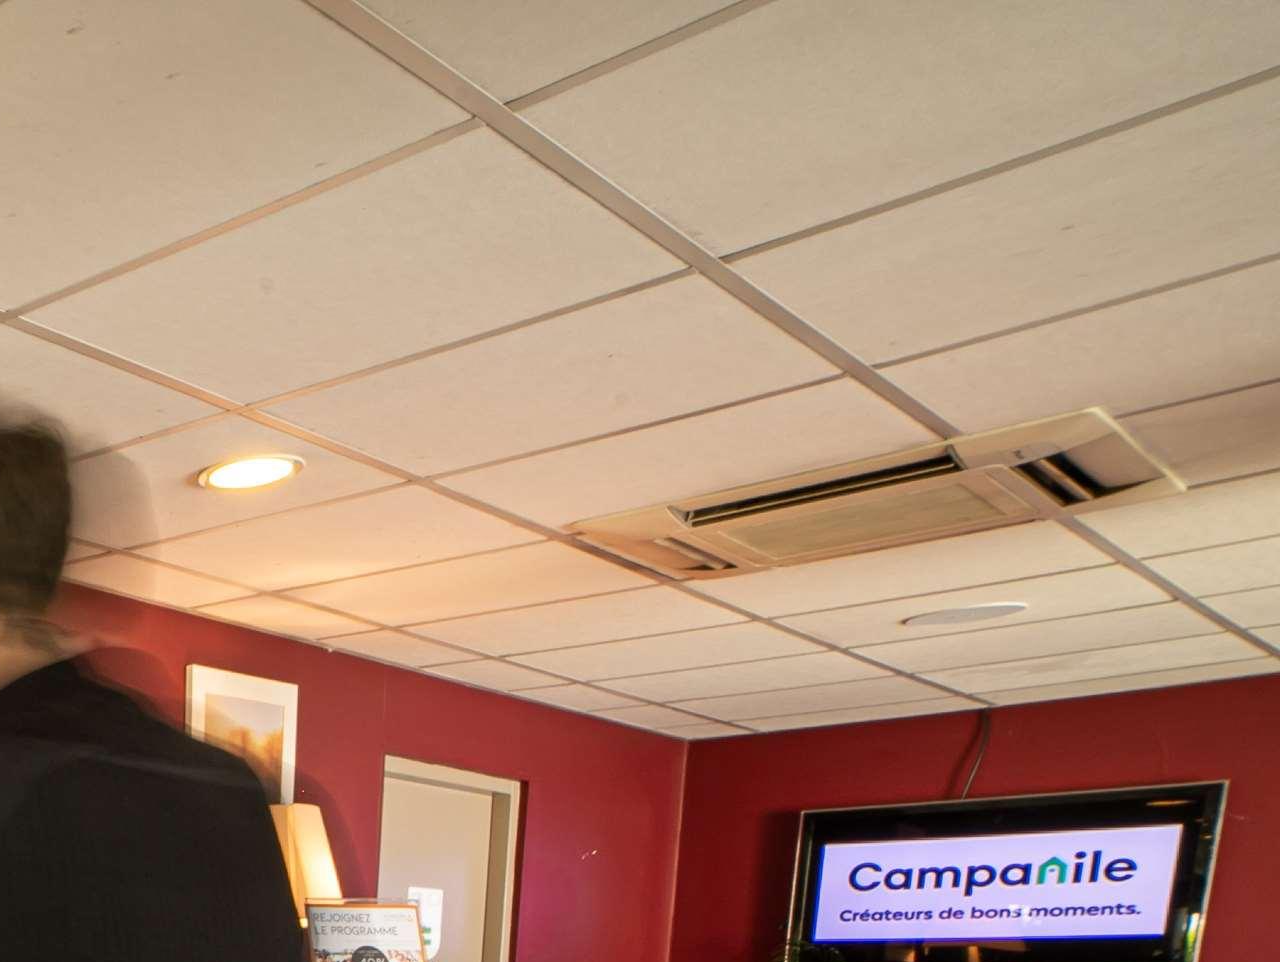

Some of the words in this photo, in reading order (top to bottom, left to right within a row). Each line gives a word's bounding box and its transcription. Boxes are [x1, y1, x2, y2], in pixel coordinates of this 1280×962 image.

[849, 850, 1138, 897] Campanile
[311, 912, 371, 923] REJOIGNEZ
[840, 907, 934, 923] Créateurs
[939, 906, 966, 921] de
[971, 905, 1022, 920] bons
[1028, 903, 1142, 918] moments.
[314, 925, 329, 936] LE
[331, 926, 400, 937] PROGRAMME
